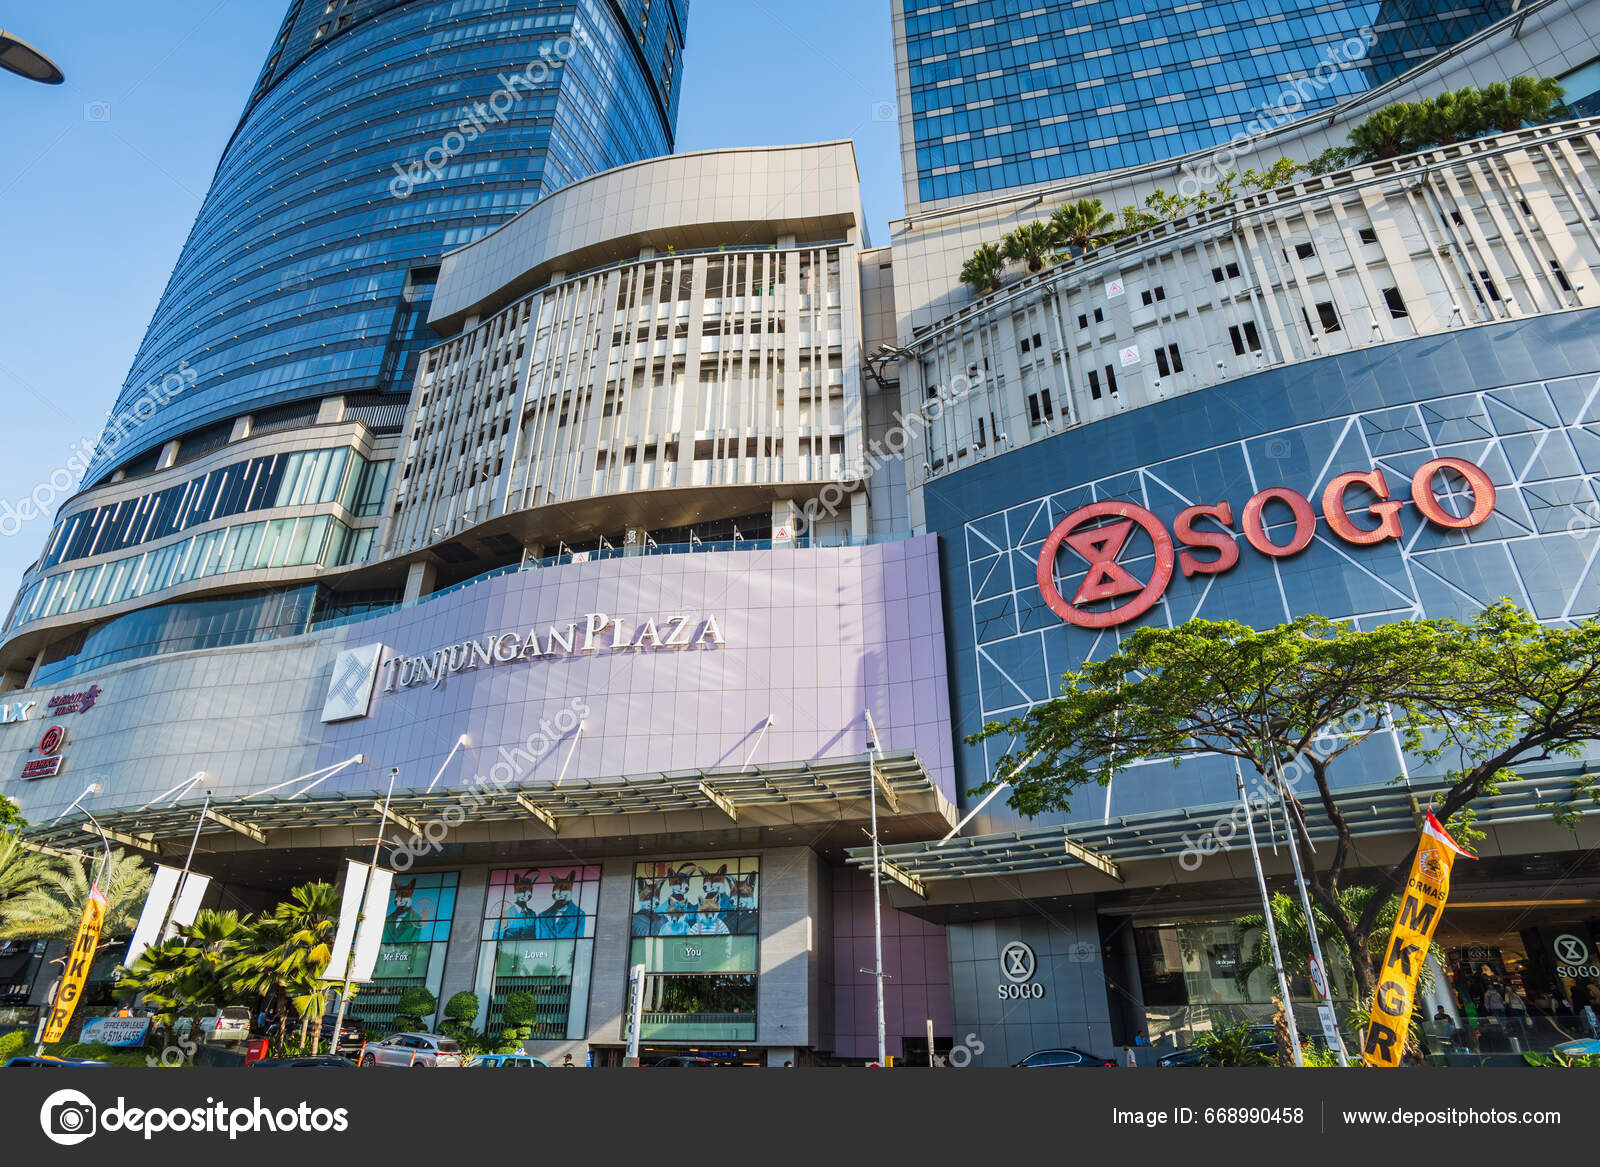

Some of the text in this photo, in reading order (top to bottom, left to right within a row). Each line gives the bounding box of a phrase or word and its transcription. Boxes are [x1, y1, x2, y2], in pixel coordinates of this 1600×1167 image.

[1173, 457, 1496, 577] SOGO
[383, 612, 727, 693] TUNJUNGAN PLAZA
[1408, 878, 1446, 901] ORMAS
[685, 947, 702, 957] You
[1556, 965, 1600, 978] SOGO
[50, 933, 96, 1028] MKGR
[998, 983, 1044, 999] SOGO
[1365, 894, 1438, 1064] MKGR
